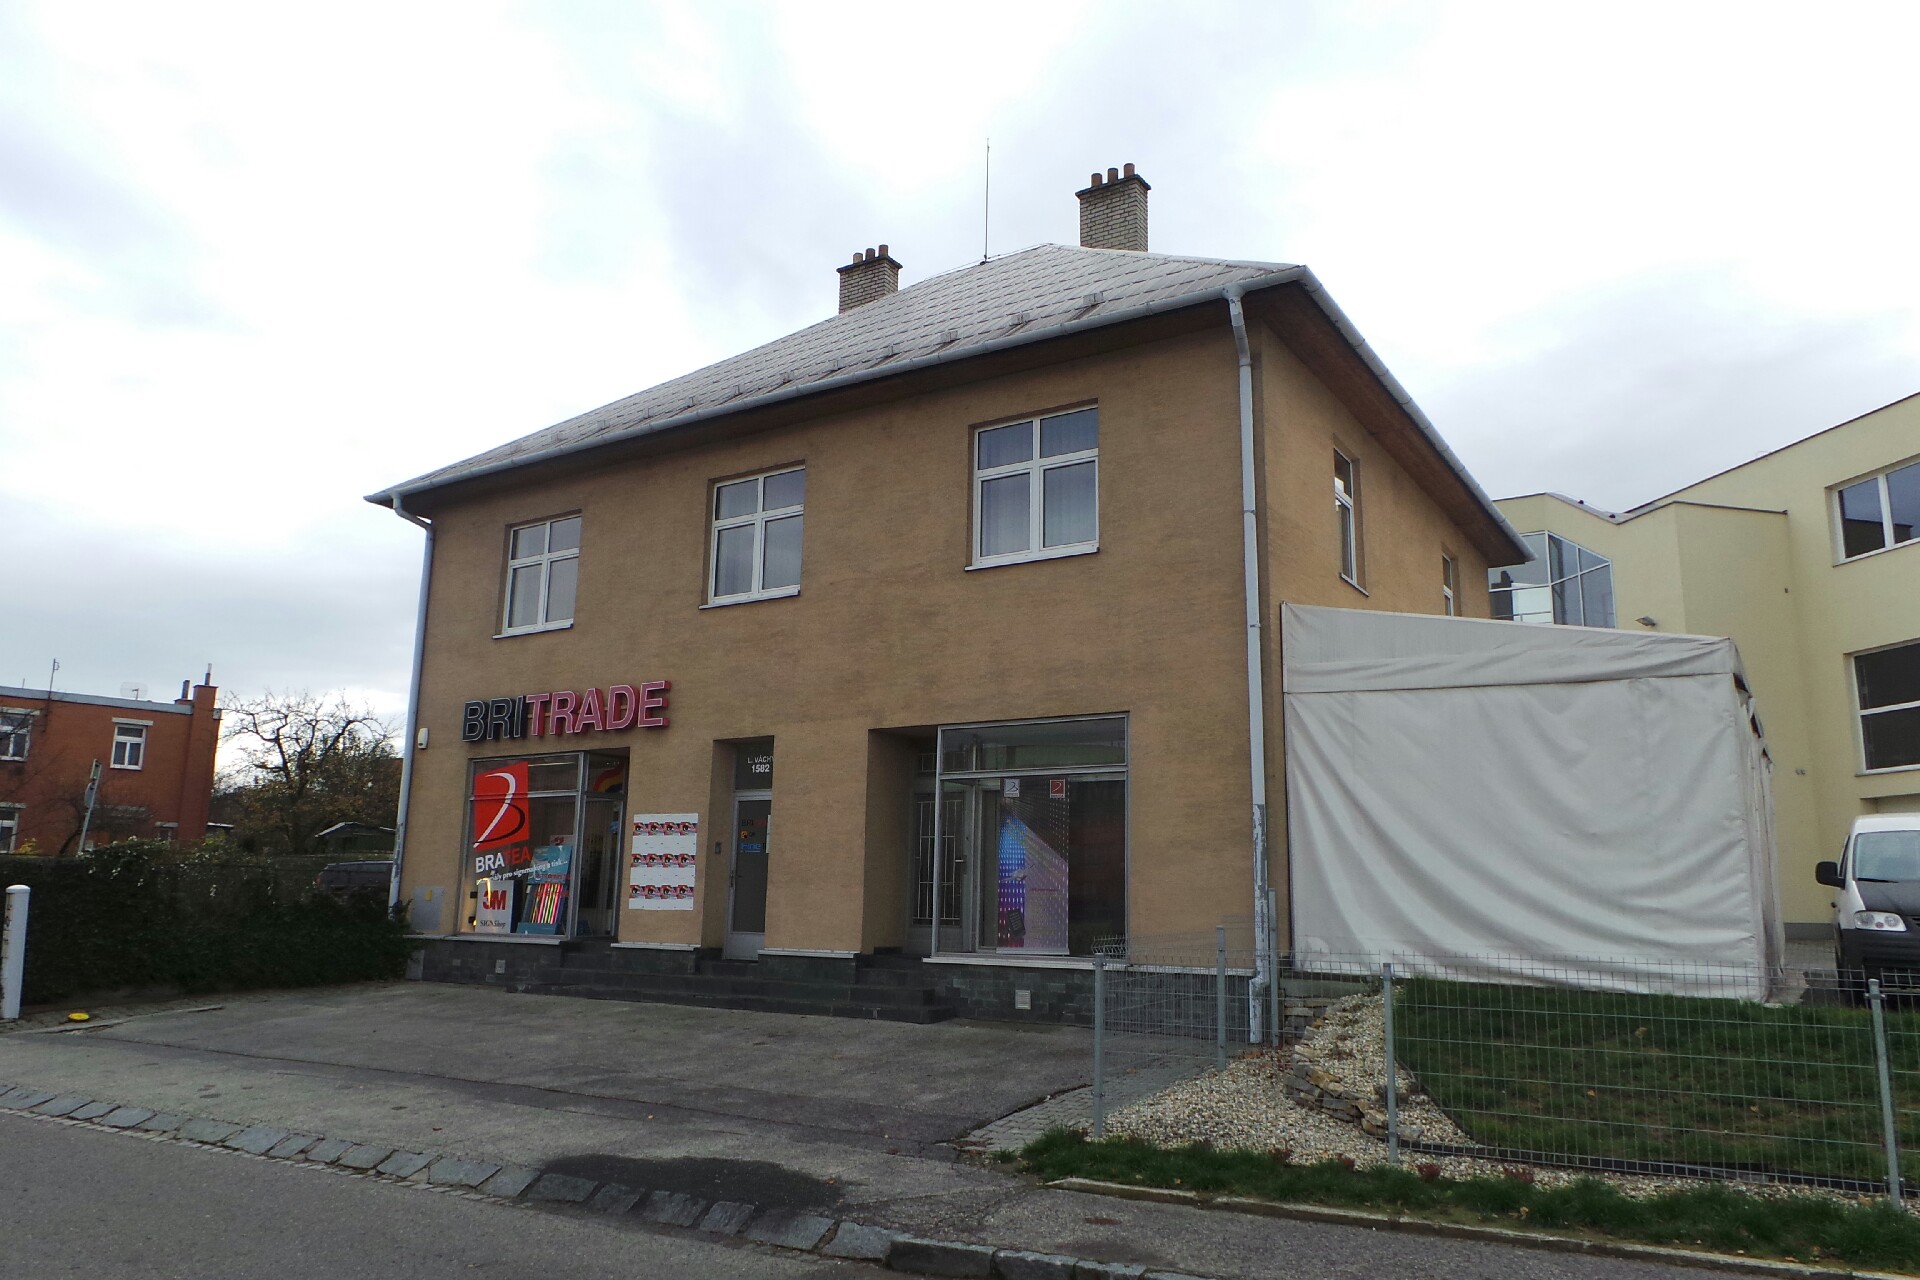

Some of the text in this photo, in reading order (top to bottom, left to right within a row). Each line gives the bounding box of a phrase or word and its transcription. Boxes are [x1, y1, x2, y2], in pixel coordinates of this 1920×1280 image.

[462, 680, 672, 742] BRITRADE
[751, 764, 770, 773] 1582
[475, 847, 531, 873] BRATEA
[482, 890, 507, 910] 3M
